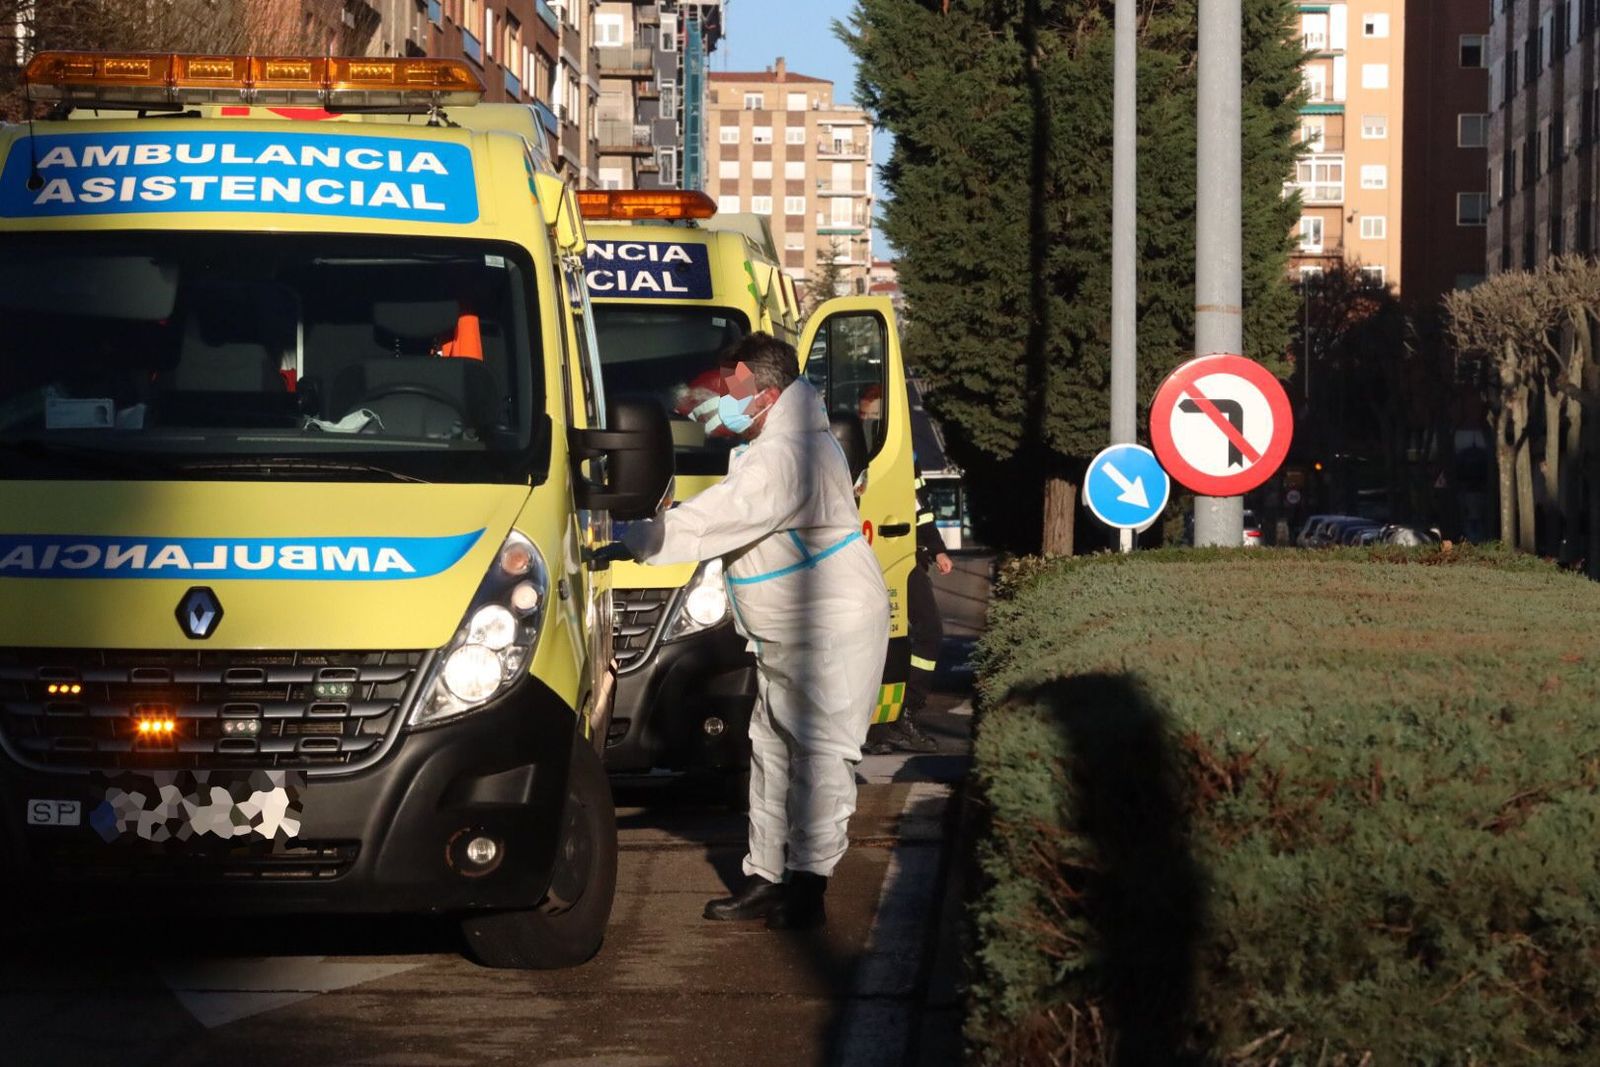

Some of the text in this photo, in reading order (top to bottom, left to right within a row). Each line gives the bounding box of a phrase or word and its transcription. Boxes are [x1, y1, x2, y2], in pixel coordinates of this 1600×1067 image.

[36, 143, 449, 175] AMBULANCIA
[33, 175, 446, 211] ASISTENCIAL
[33, 802, 76, 824] SP
